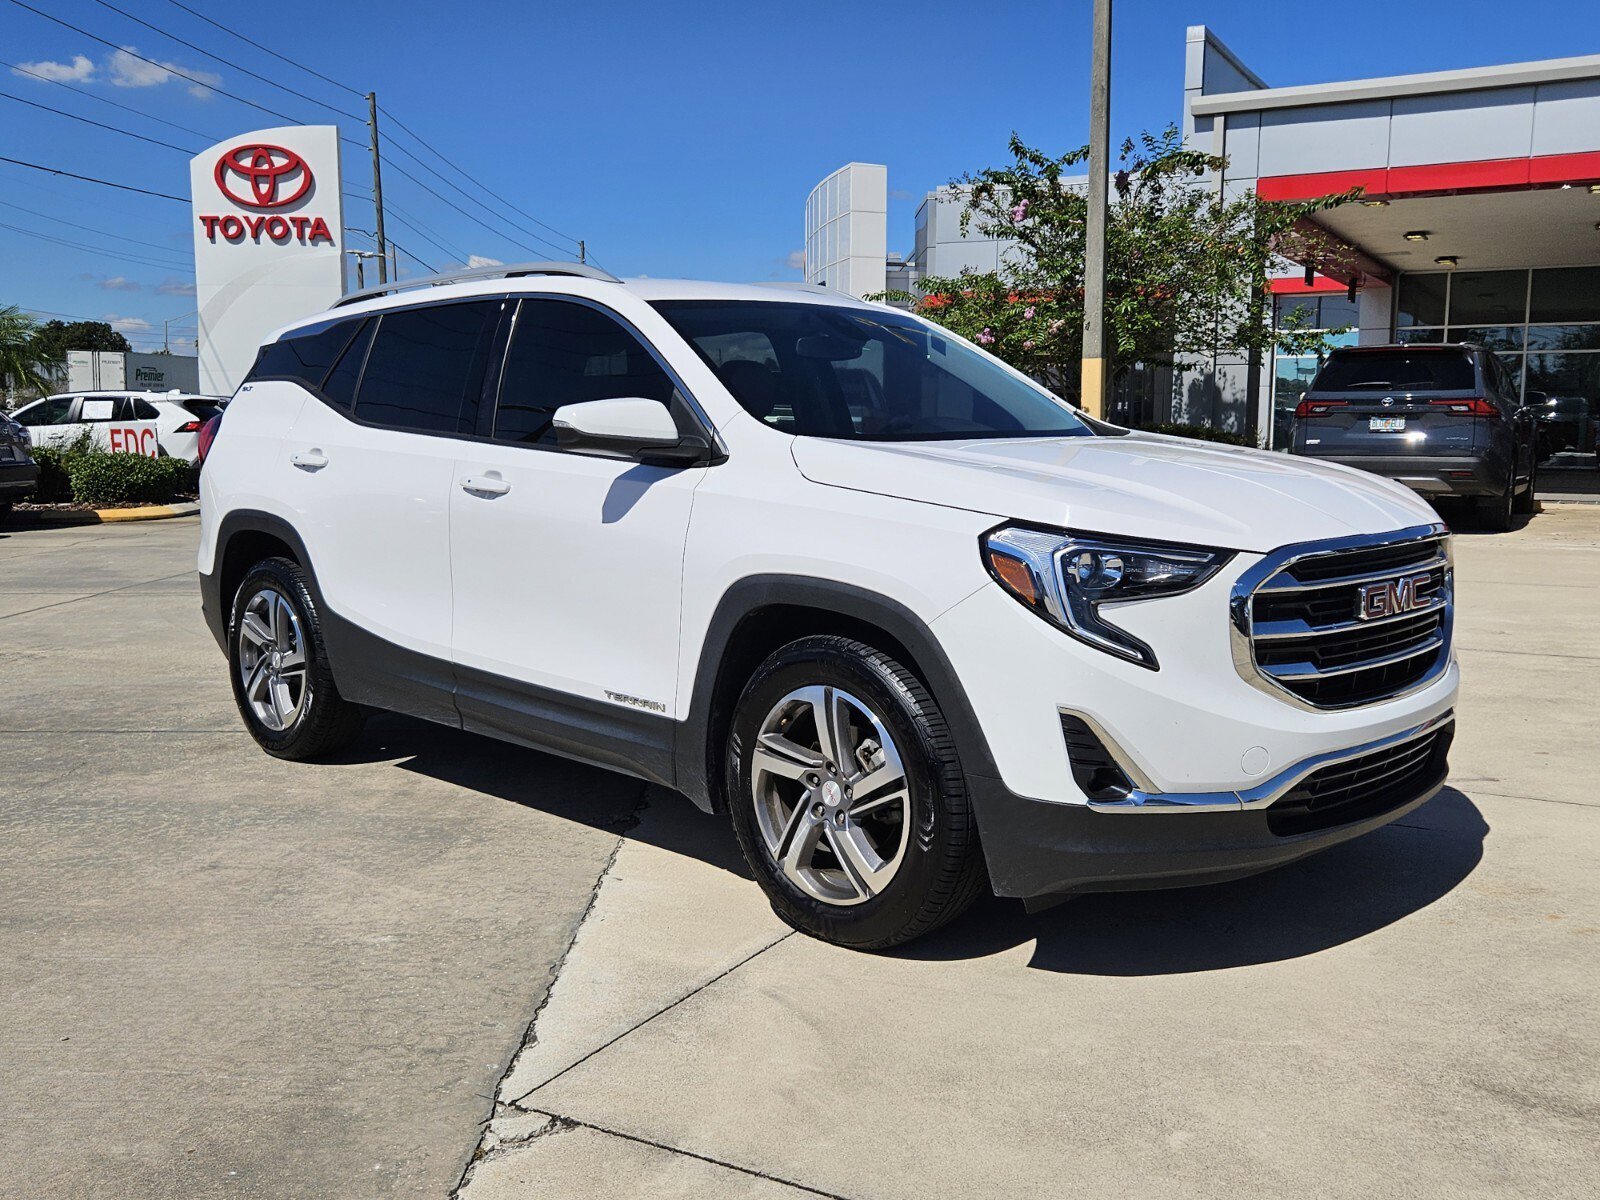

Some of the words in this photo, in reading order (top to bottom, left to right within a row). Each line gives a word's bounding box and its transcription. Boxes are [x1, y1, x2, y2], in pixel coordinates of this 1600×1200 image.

[199, 215, 332, 240] TOYOTA
[136, 368, 164, 381] Premier
[1361, 573, 1431, 620] GMC
[604, 689, 666, 713] TERRAIN
